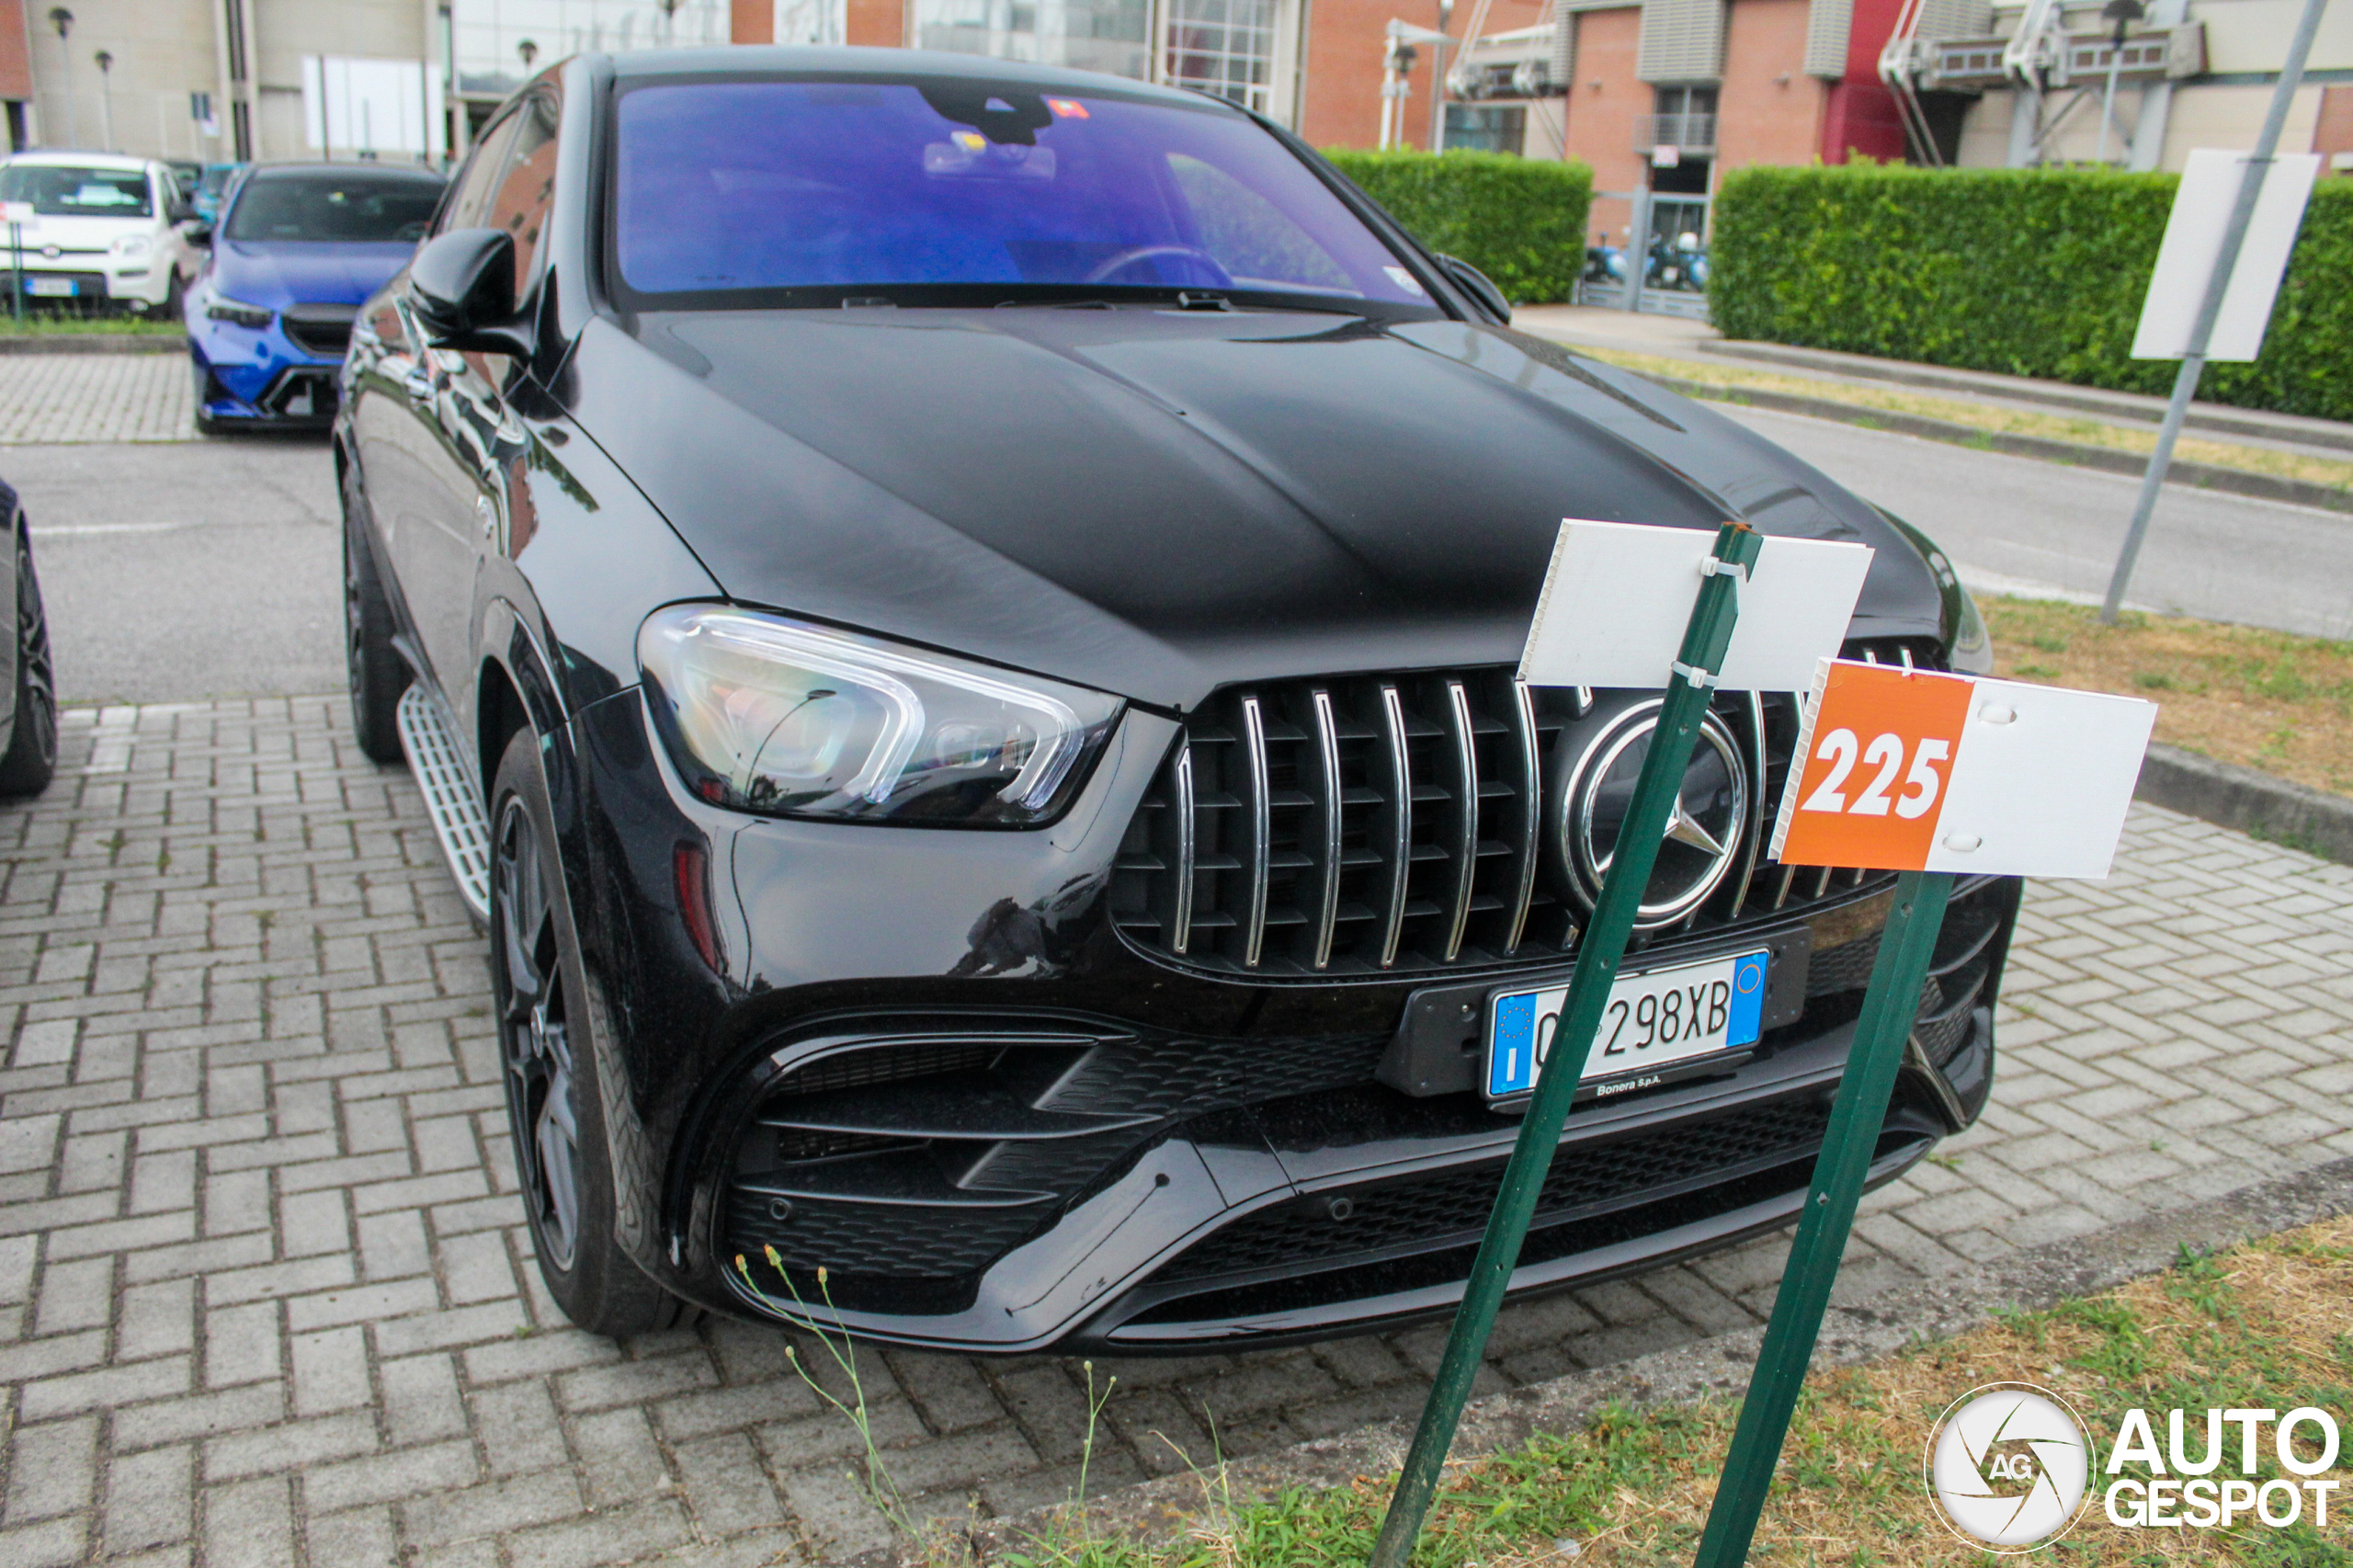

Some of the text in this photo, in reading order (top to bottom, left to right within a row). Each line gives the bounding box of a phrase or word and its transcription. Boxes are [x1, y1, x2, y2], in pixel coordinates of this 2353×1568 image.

[1800, 727, 1949, 820] 225
[1597, 1074, 1662, 1096] Bonera S.p.A.
